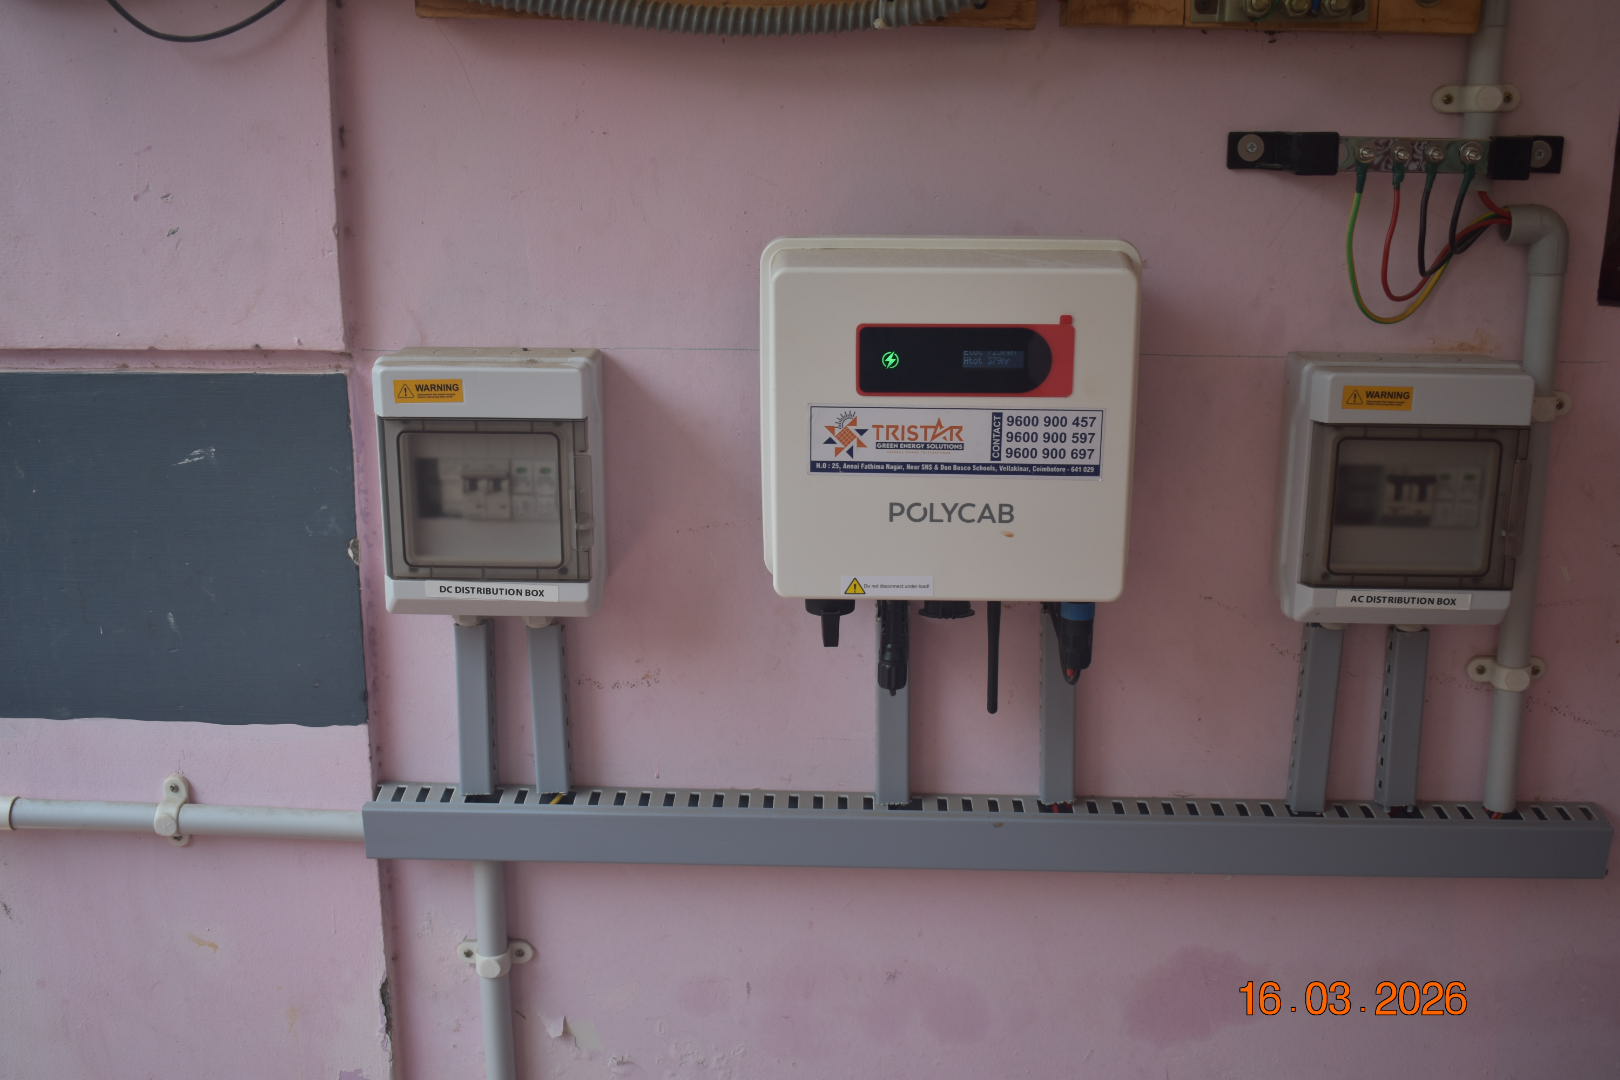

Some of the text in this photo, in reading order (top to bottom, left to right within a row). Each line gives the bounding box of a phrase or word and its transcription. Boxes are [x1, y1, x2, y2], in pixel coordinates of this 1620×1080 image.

[415, 383, 460, 392] WARNING
[1365, 391, 1410, 400] WARNING
[1006, 415, 1097, 428] 9600 900 457
[871, 417, 964, 442] TRISTAR
[992, 415, 1002, 459] CONTACT
[1005, 431, 1096, 444] 9600 900 597
[1005, 447, 1095, 460] 9600 900 697
[889, 502, 1015, 524] POLYCAB
[439, 585, 545, 597] DC DISTRIBUTION BOX
[1350, 595, 1457, 606] AC DISTRIBUTION BOX
